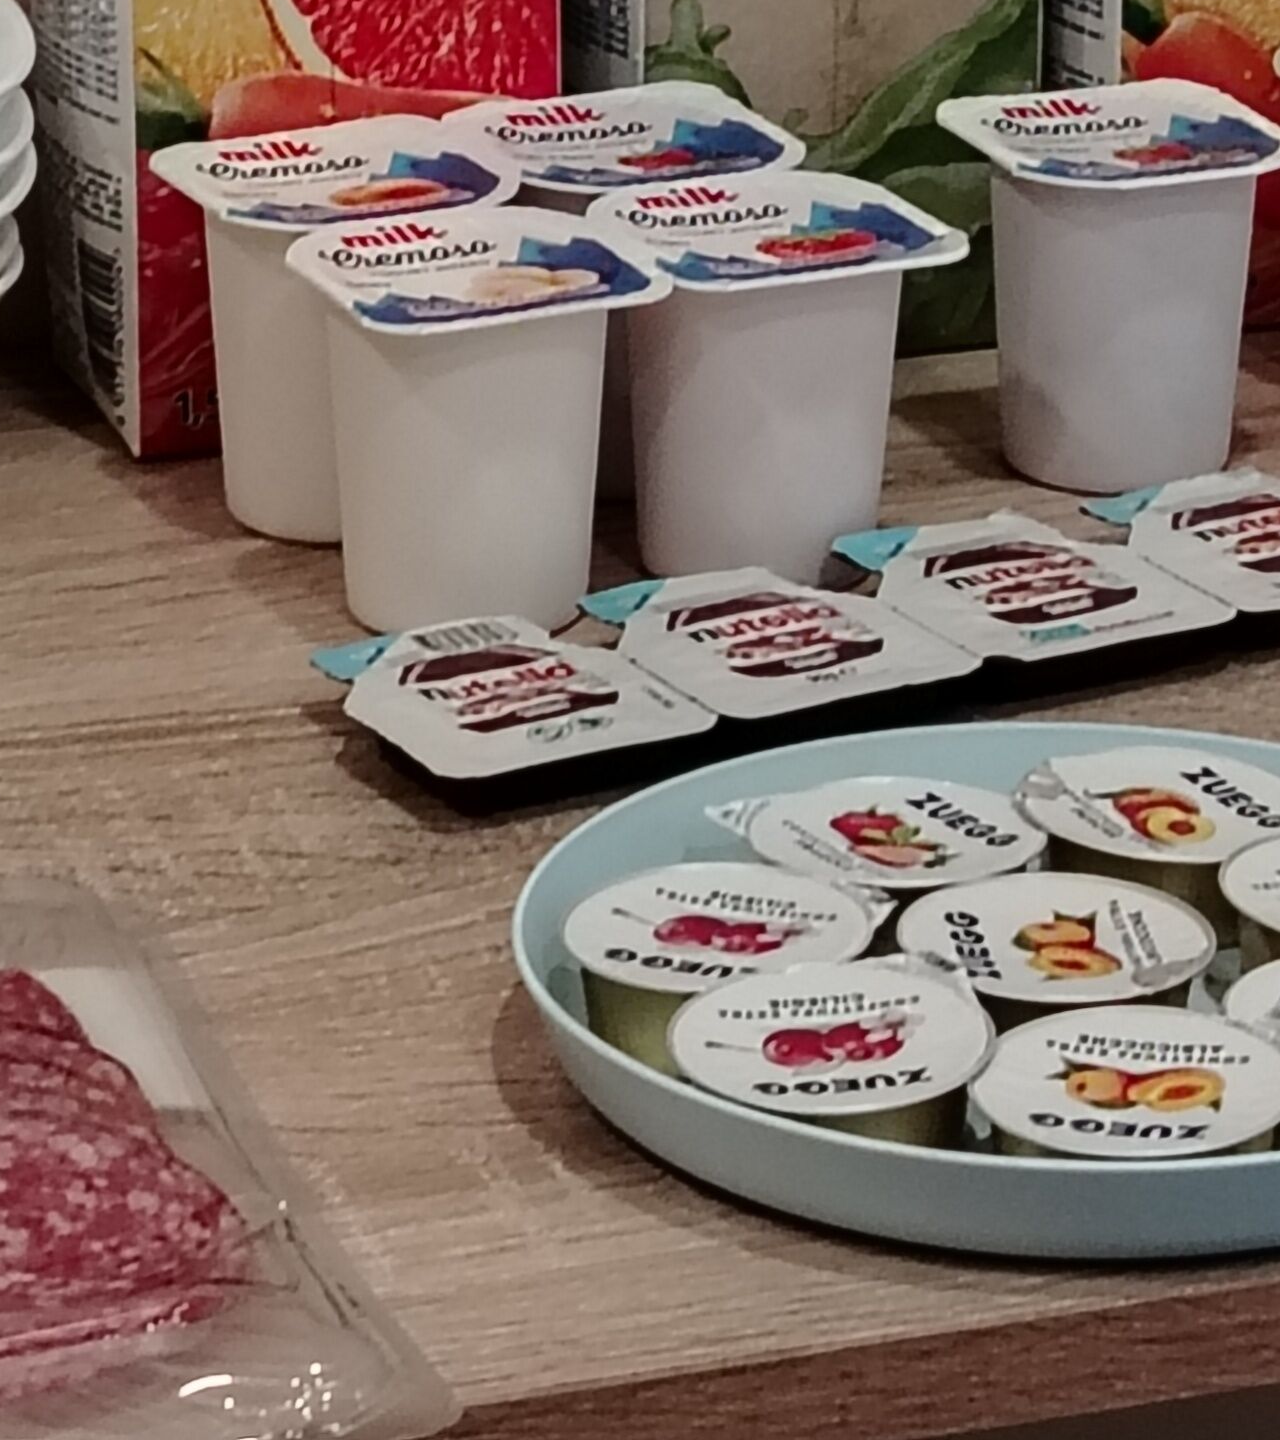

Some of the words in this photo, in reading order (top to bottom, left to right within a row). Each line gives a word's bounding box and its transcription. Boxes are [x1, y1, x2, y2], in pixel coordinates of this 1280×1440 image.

[505, 103, 608, 127] milk
[1001, 96, 1103, 120] milk
[218, 140, 323, 162] milk
[634, 186, 739, 210] milk
[340, 223, 449, 248] milk
[686, 603, 841, 644] nutella
[418, 661, 577, 702] nutella
[905, 792, 1019, 848] ZUEGG
[604, 947, 758, 980] UEGG
[753, 1067, 931, 1096] ZUEGG
[1028, 1112, 1212, 1141] ZUEGG
